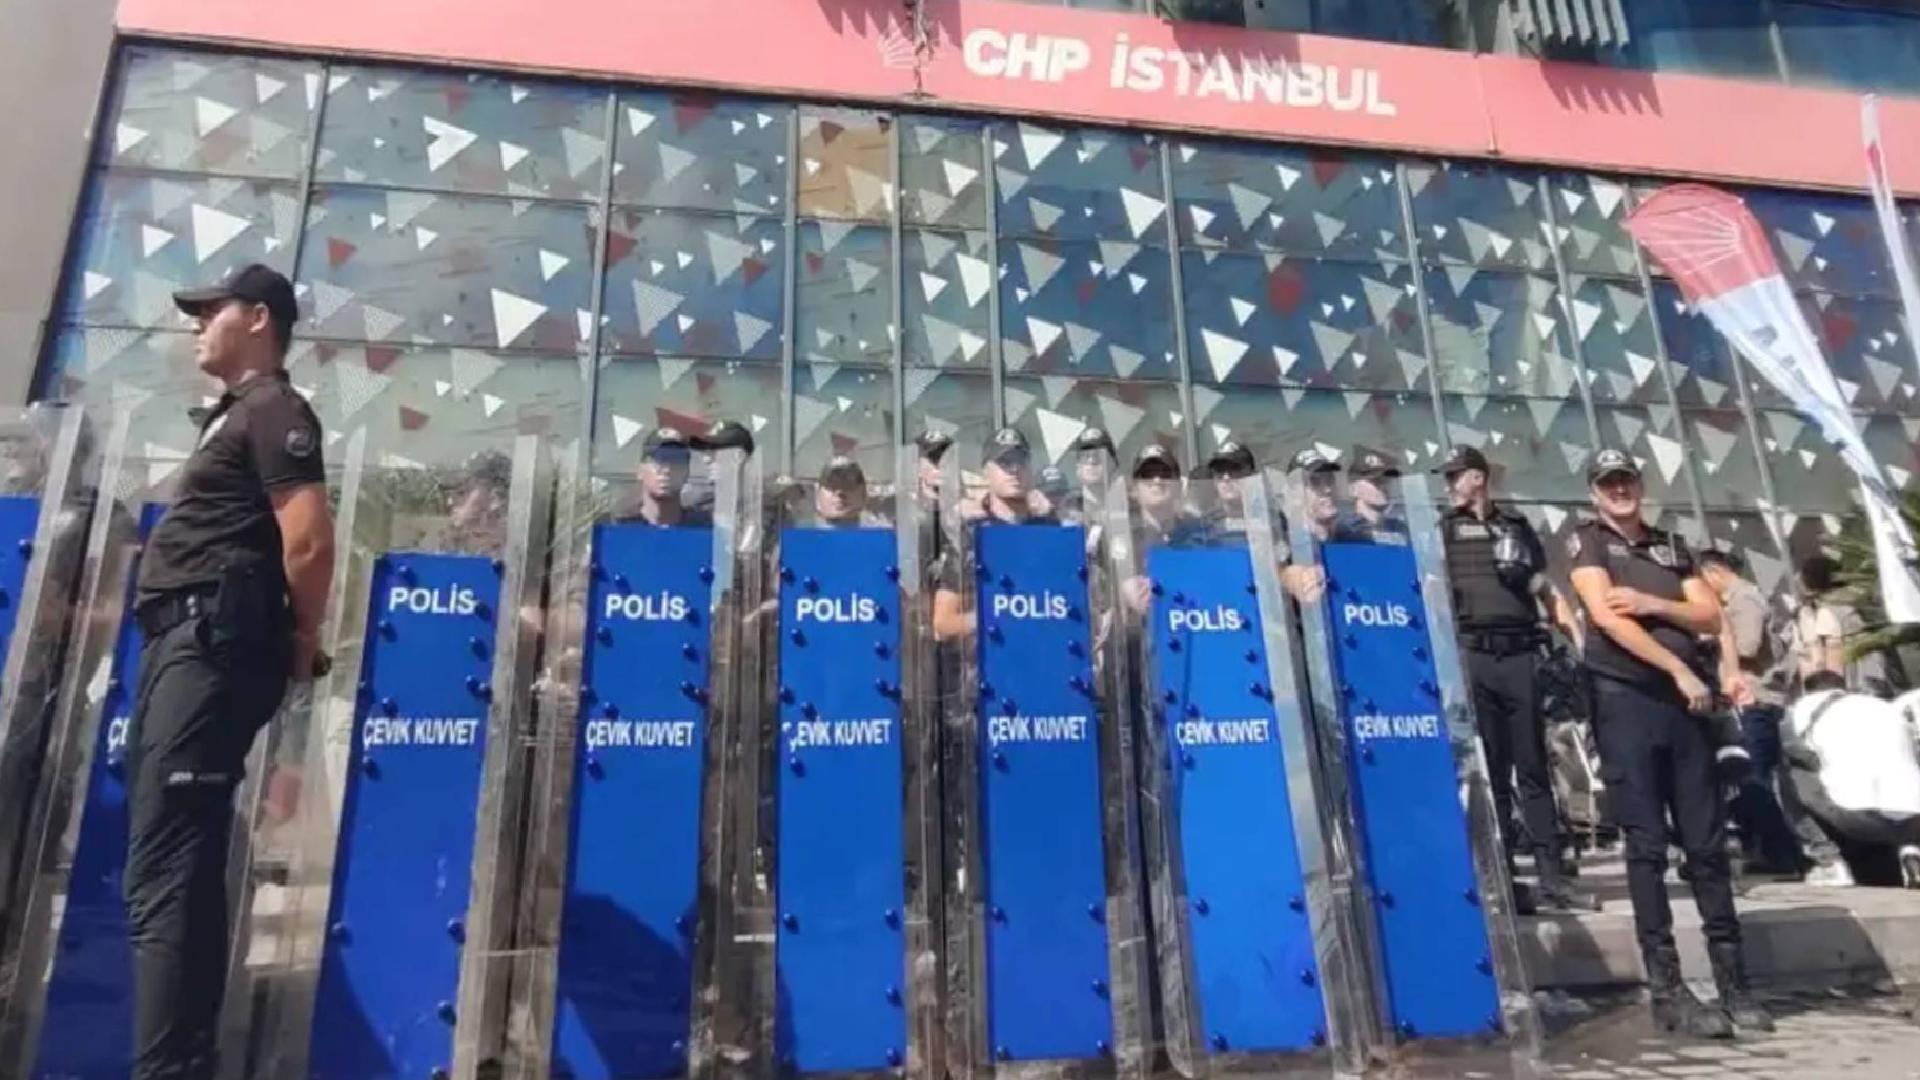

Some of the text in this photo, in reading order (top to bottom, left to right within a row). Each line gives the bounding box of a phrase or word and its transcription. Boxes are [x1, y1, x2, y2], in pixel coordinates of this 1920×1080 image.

[963, 27, 1397, 116] CHP İSTANBUL
[389, 583, 475, 615] POLİS
[606, 590, 685, 620] POLİS
[797, 592, 875, 621] POLİS
[993, 589, 1067, 618] POLİS
[1168, 605, 1241, 632] POLİS
[1344, 601, 1409, 627] POLİS
[414, 718, 479, 745] KUVVET
[634, 720, 694, 746] KUVVET
[834, 718, 891, 745] KUVVET
[1034, 715, 1086, 742] KUVVET
[1217, 718, 1269, 743] KUVVET
[1393, 715, 1437, 738] KUVVET
